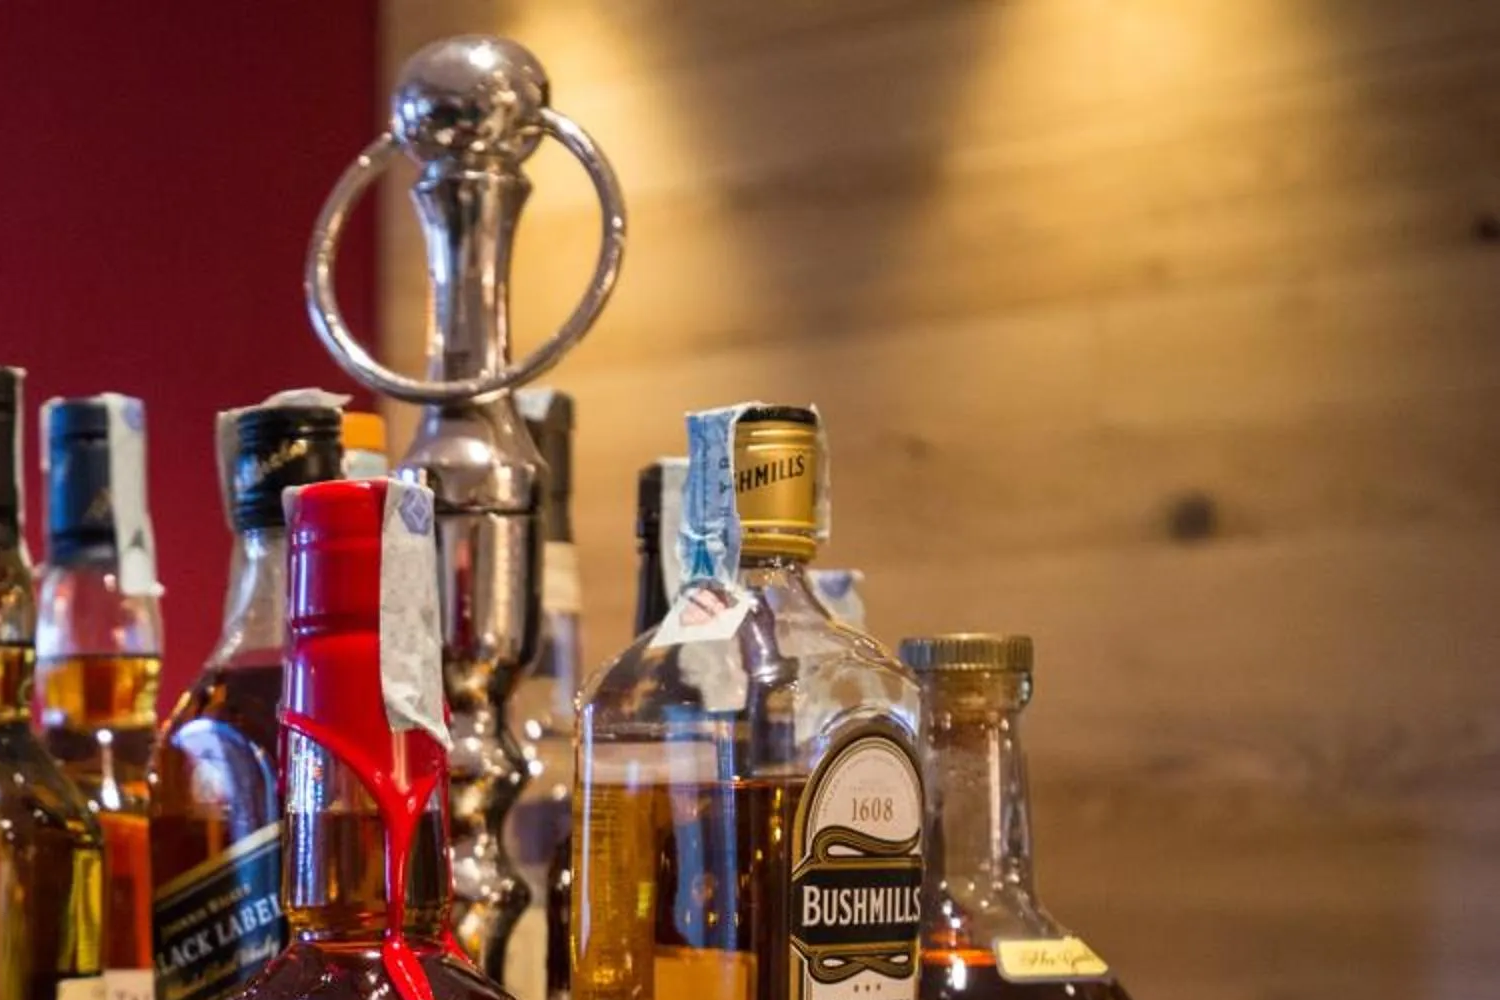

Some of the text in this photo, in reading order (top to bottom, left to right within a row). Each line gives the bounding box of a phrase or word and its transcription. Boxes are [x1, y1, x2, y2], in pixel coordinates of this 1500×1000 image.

[736, 454, 805, 493] HMILLS
[851, 797, 894, 822] 1608
[802, 884, 921, 928] BUSHMILLS
[157, 931, 214, 976] LACK
